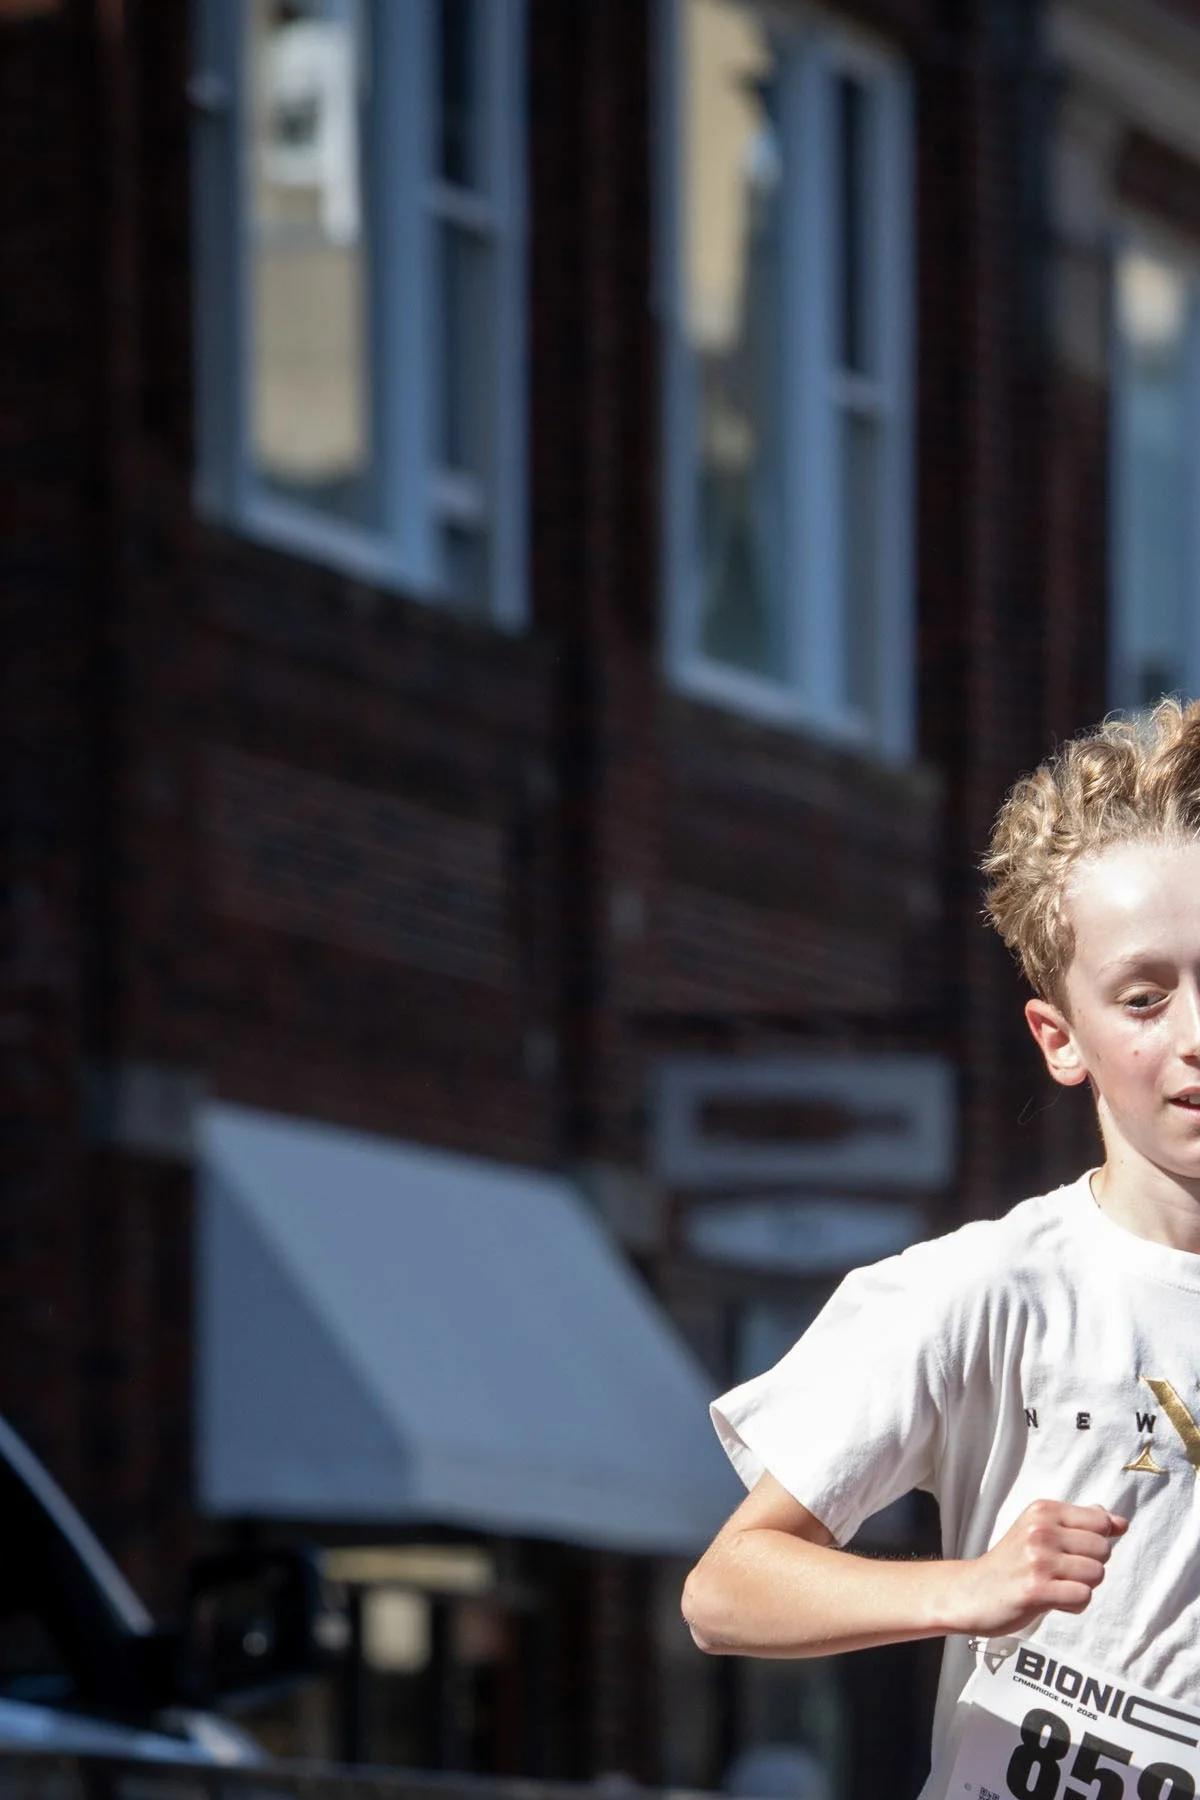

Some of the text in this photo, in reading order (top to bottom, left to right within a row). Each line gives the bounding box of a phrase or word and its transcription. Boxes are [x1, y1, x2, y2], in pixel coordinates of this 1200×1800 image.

[1024, 1408, 1157, 1434] NEW
[1012, 1674, 1060, 1701] CAMBRIDGE
[1076, 1706, 1099, 1721] 2026
